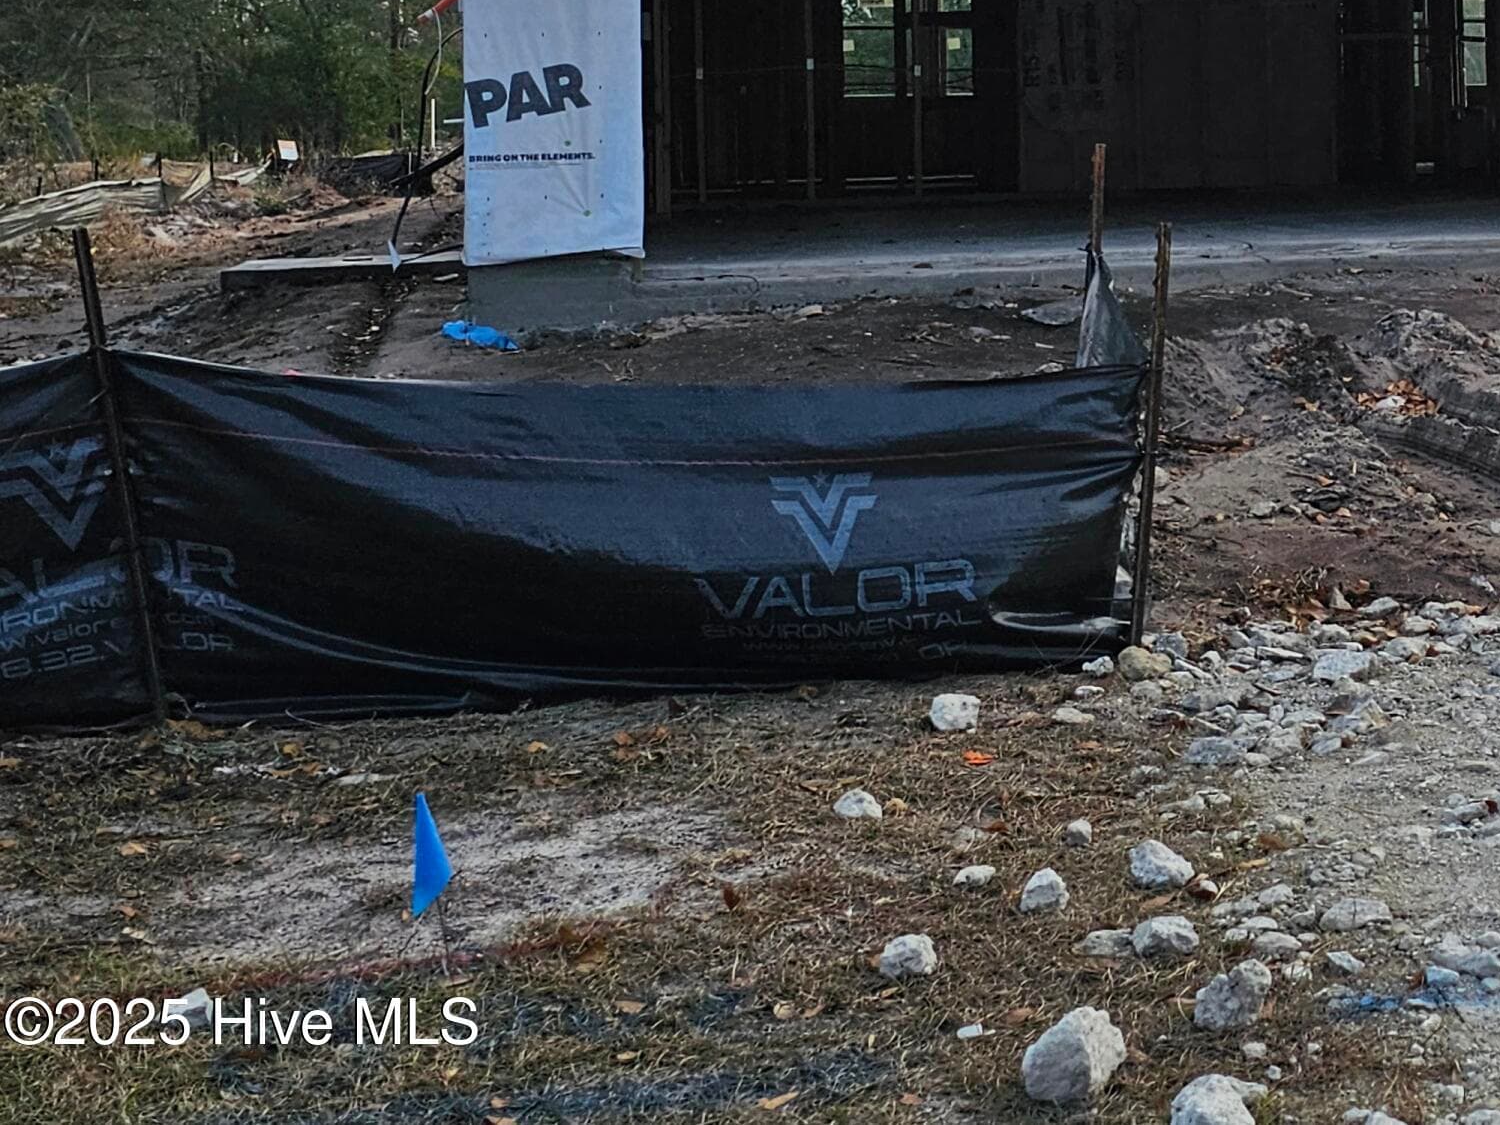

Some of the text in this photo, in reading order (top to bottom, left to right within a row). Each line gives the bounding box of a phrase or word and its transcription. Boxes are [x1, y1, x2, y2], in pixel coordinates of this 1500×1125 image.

[469, 152, 596, 163] BRING ON THE ELEMENTS.
[694, 558, 978, 619] VALOR
[700, 609, 982, 640] ENVIRONMENTAL
